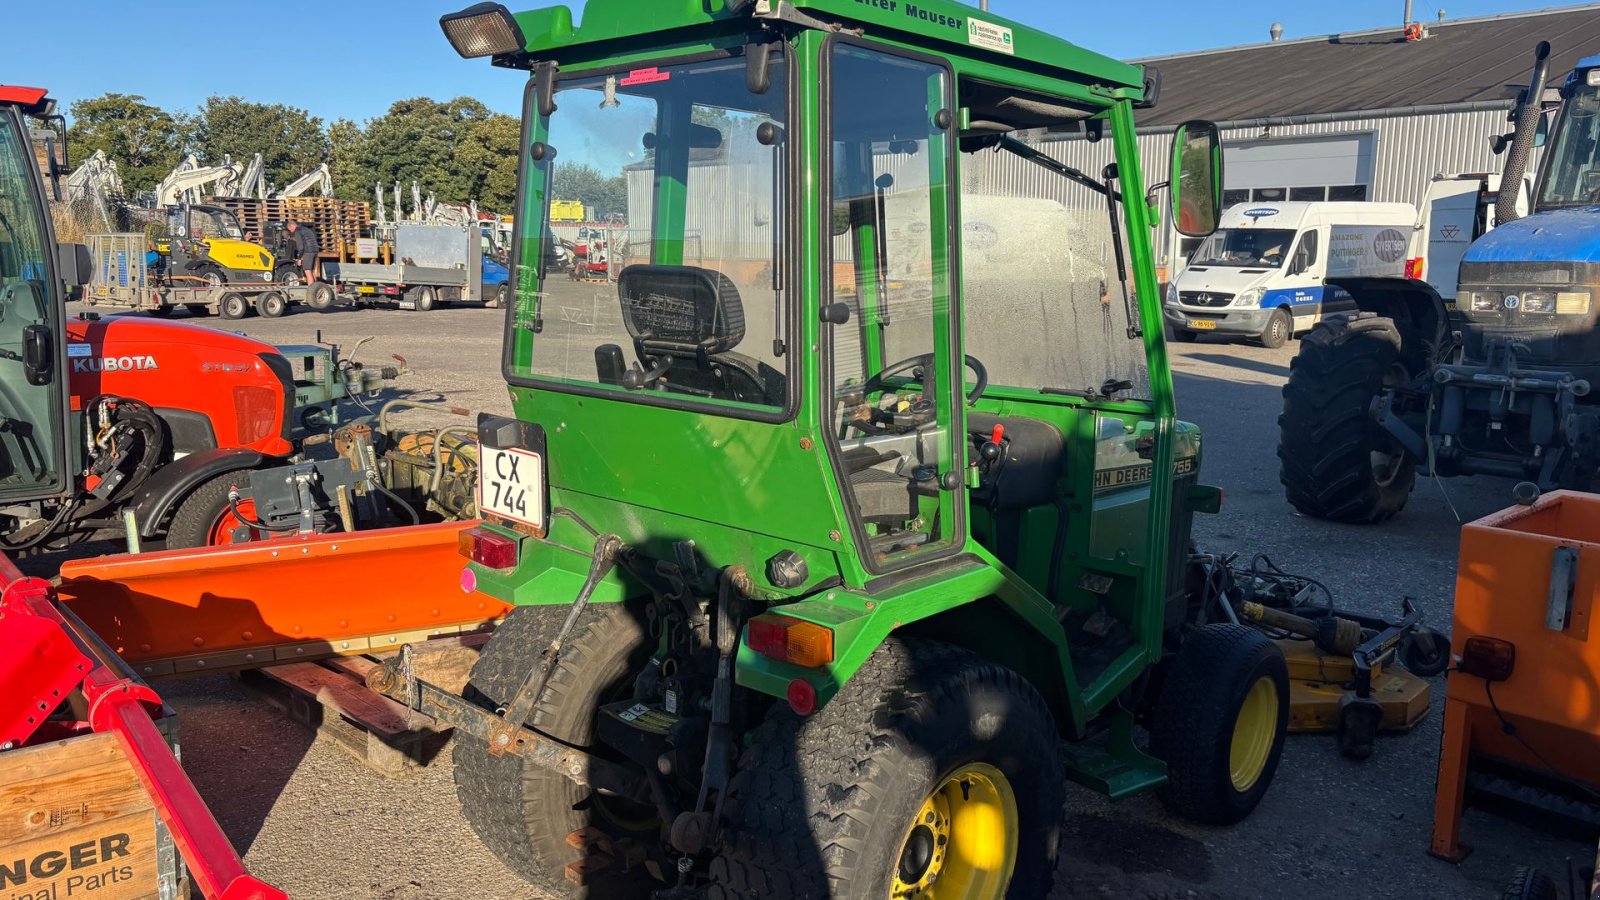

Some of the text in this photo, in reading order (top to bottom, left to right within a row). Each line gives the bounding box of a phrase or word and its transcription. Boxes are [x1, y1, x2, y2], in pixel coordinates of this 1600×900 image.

[905, 3, 963, 29] Mauser
[1375, 239, 1406, 252] SIVERTSEN
[74, 355, 159, 373] KUBOTA
[495, 451, 520, 484] CX
[1116, 466, 1153, 483] DEERE
[491, 480, 526, 517] 744
[0, 832, 131, 890] NGER
[67, 865, 133, 896] Parts
